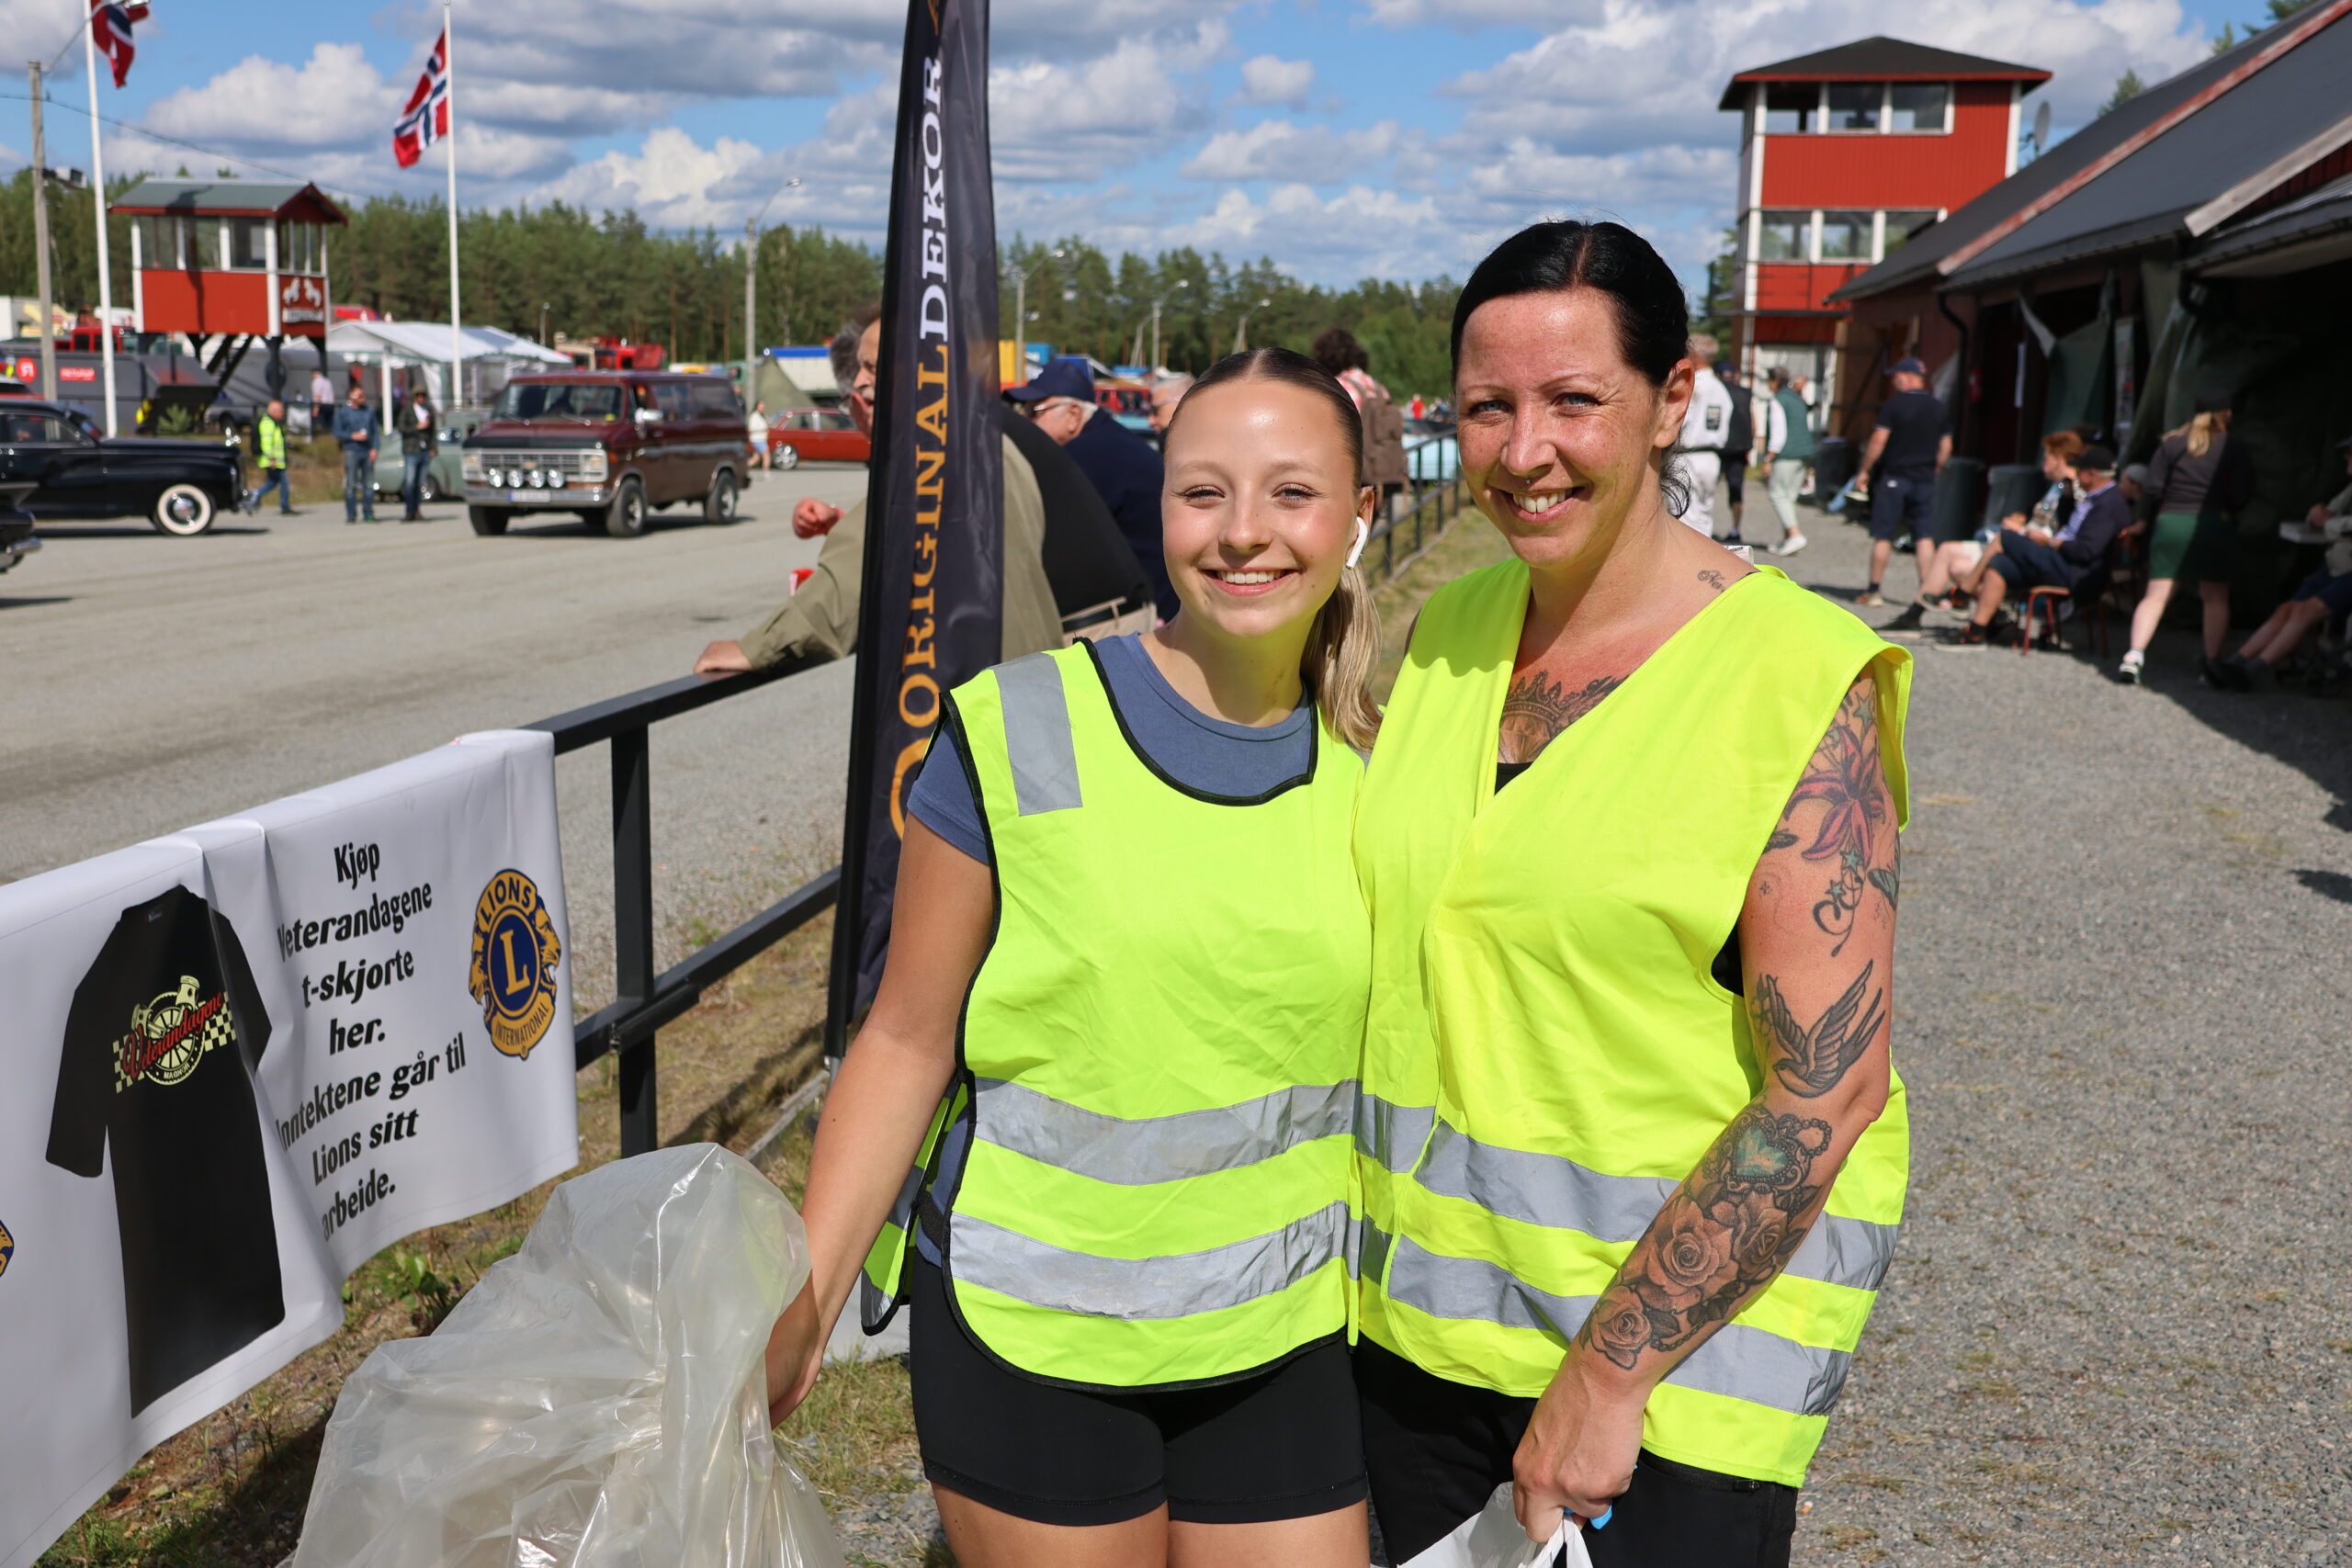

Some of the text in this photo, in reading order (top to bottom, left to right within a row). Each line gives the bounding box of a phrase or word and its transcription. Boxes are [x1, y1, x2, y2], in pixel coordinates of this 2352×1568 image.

[334, 841, 380, 890] Kjøp
[277, 883, 433, 963] Veterandagene
[480, 877, 532, 923] LIONS
[302, 949, 414, 1009] t-skjorte
[499, 929, 531, 996] L
[330, 1018, 386, 1055] her.
[493, 1001, 549, 1046] INTERNATIONAL
[276, 1032, 467, 1155] Inntektene går til
[312, 1108, 419, 1186] Lions sitt
[322, 1168, 396, 1242] arbeide.
